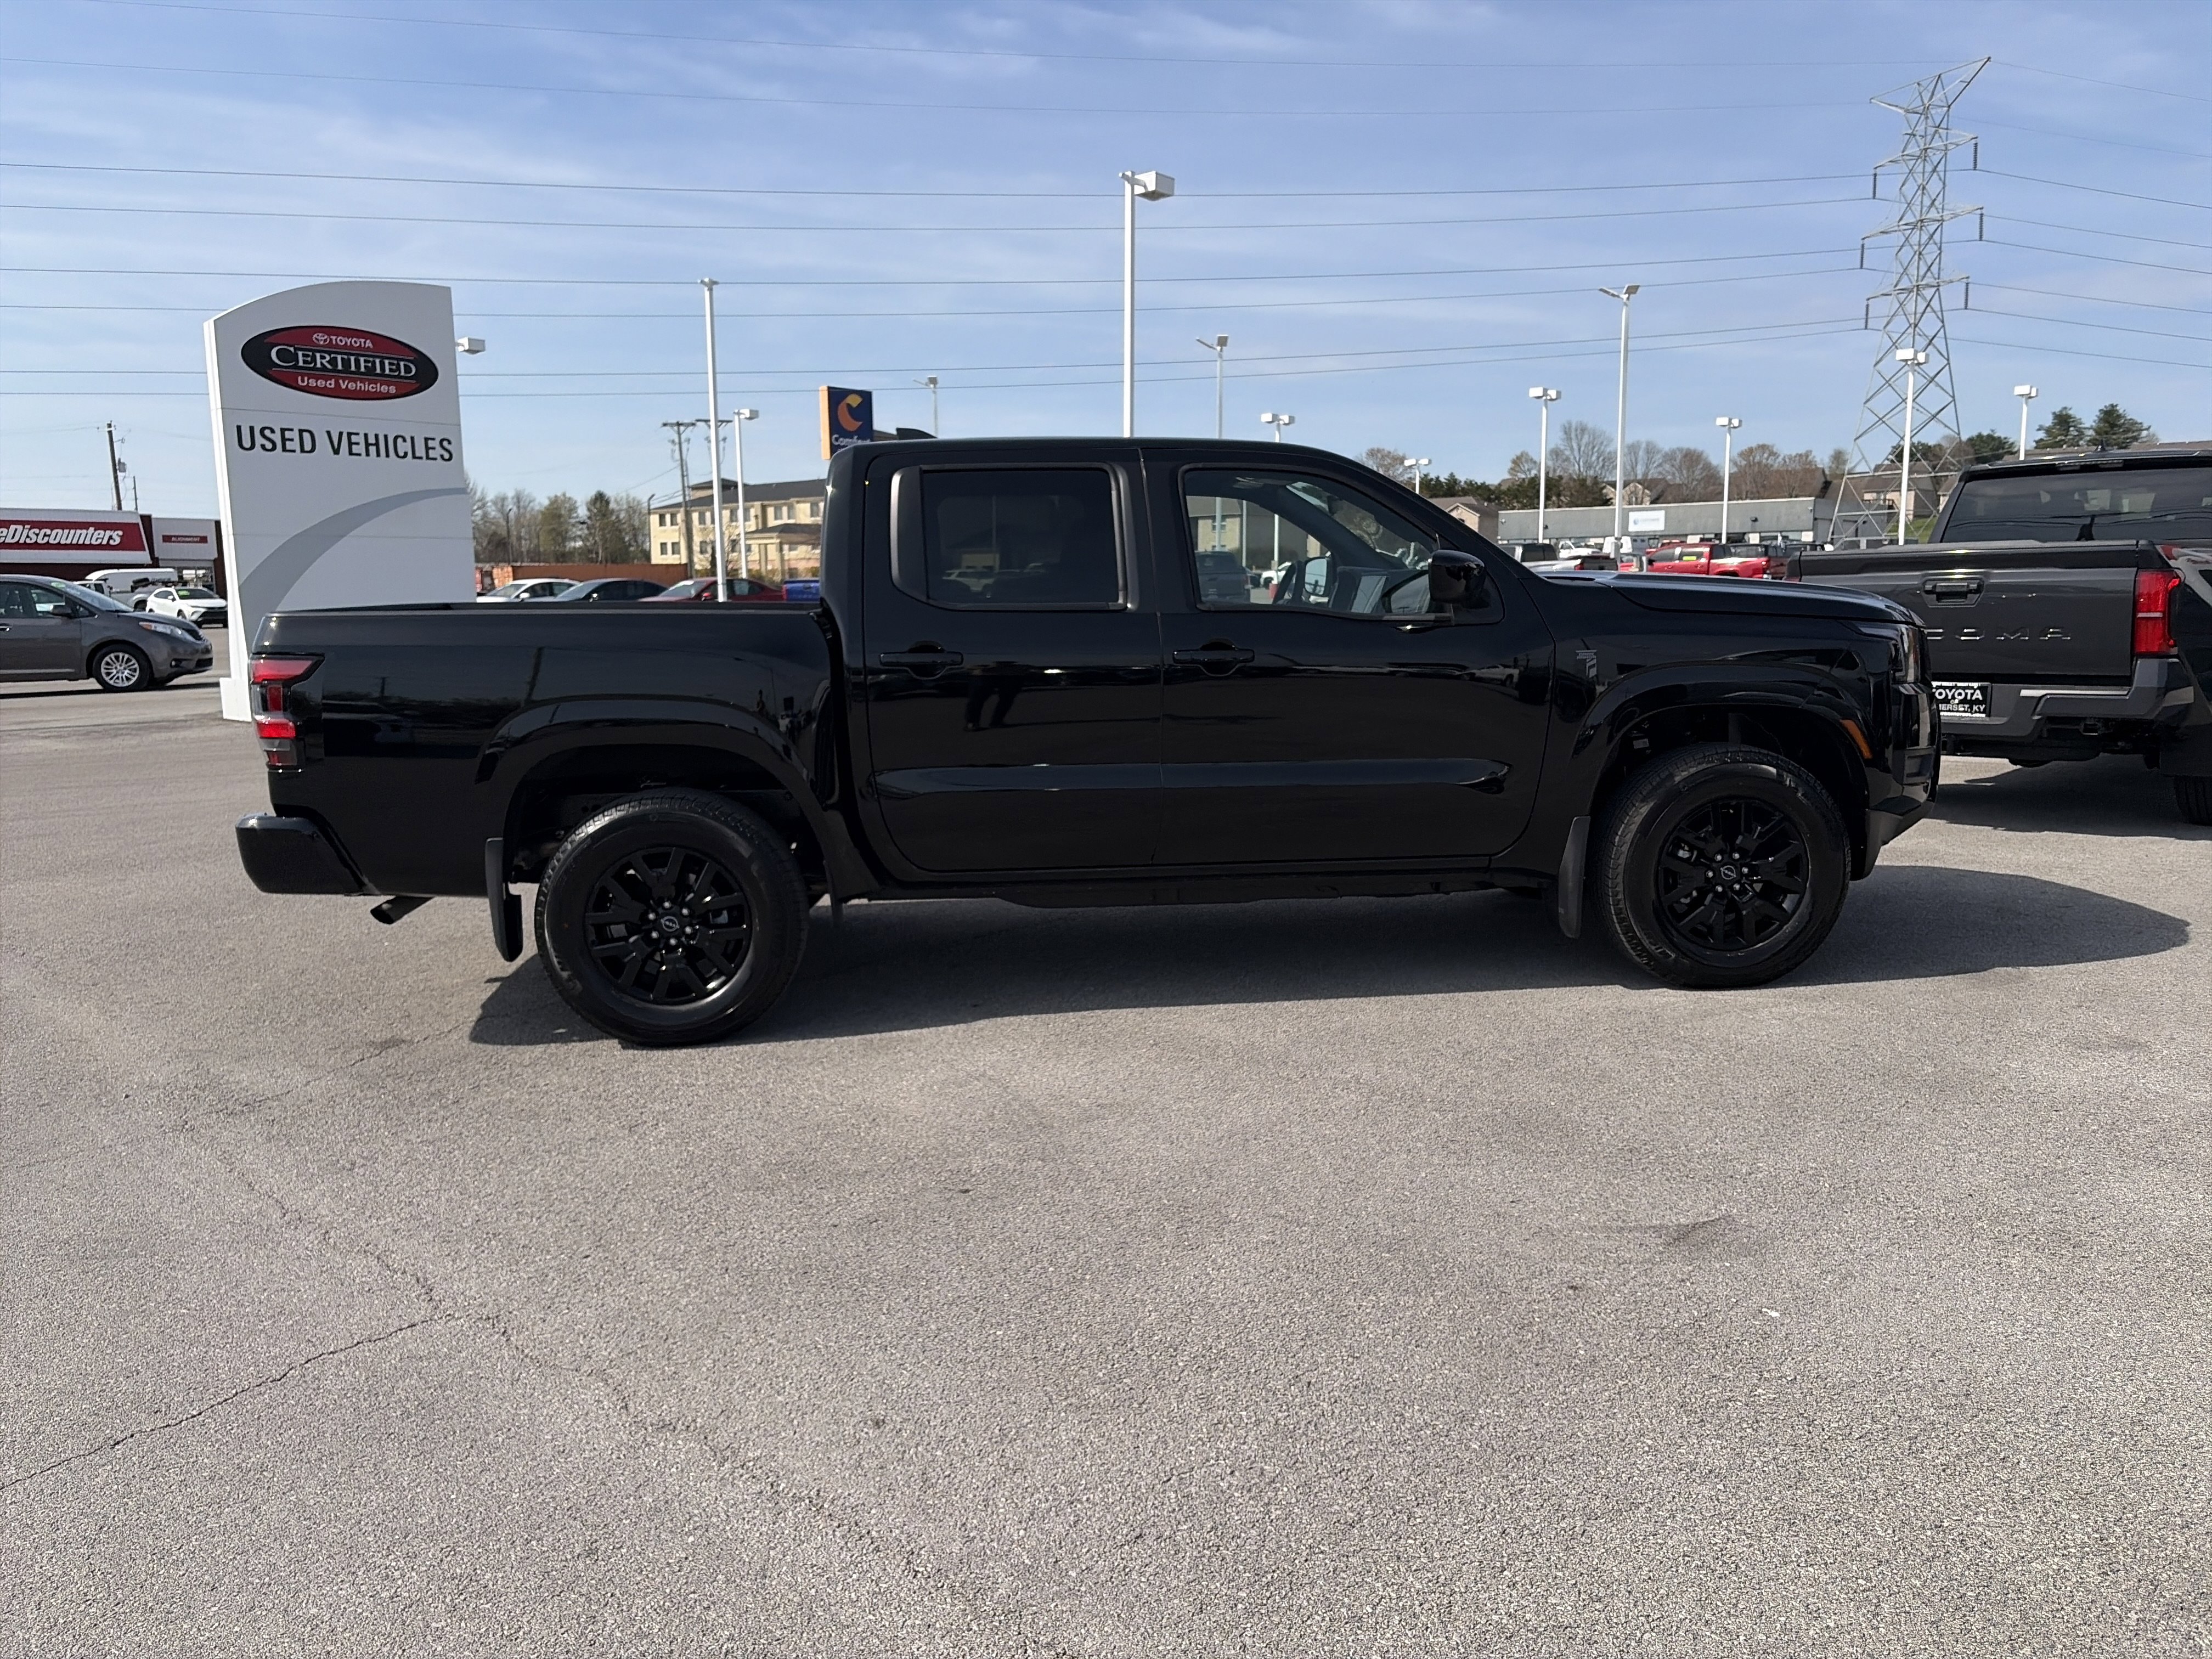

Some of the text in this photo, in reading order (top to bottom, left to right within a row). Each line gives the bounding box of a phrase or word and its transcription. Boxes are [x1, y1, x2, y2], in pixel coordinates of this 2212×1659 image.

[330, 336, 373, 348] TOYOTA
[270, 345, 416, 377] CERTIFIED
[298, 375, 396, 394] Used Vehicles
[236, 425, 454, 462] USED VEHICLES
